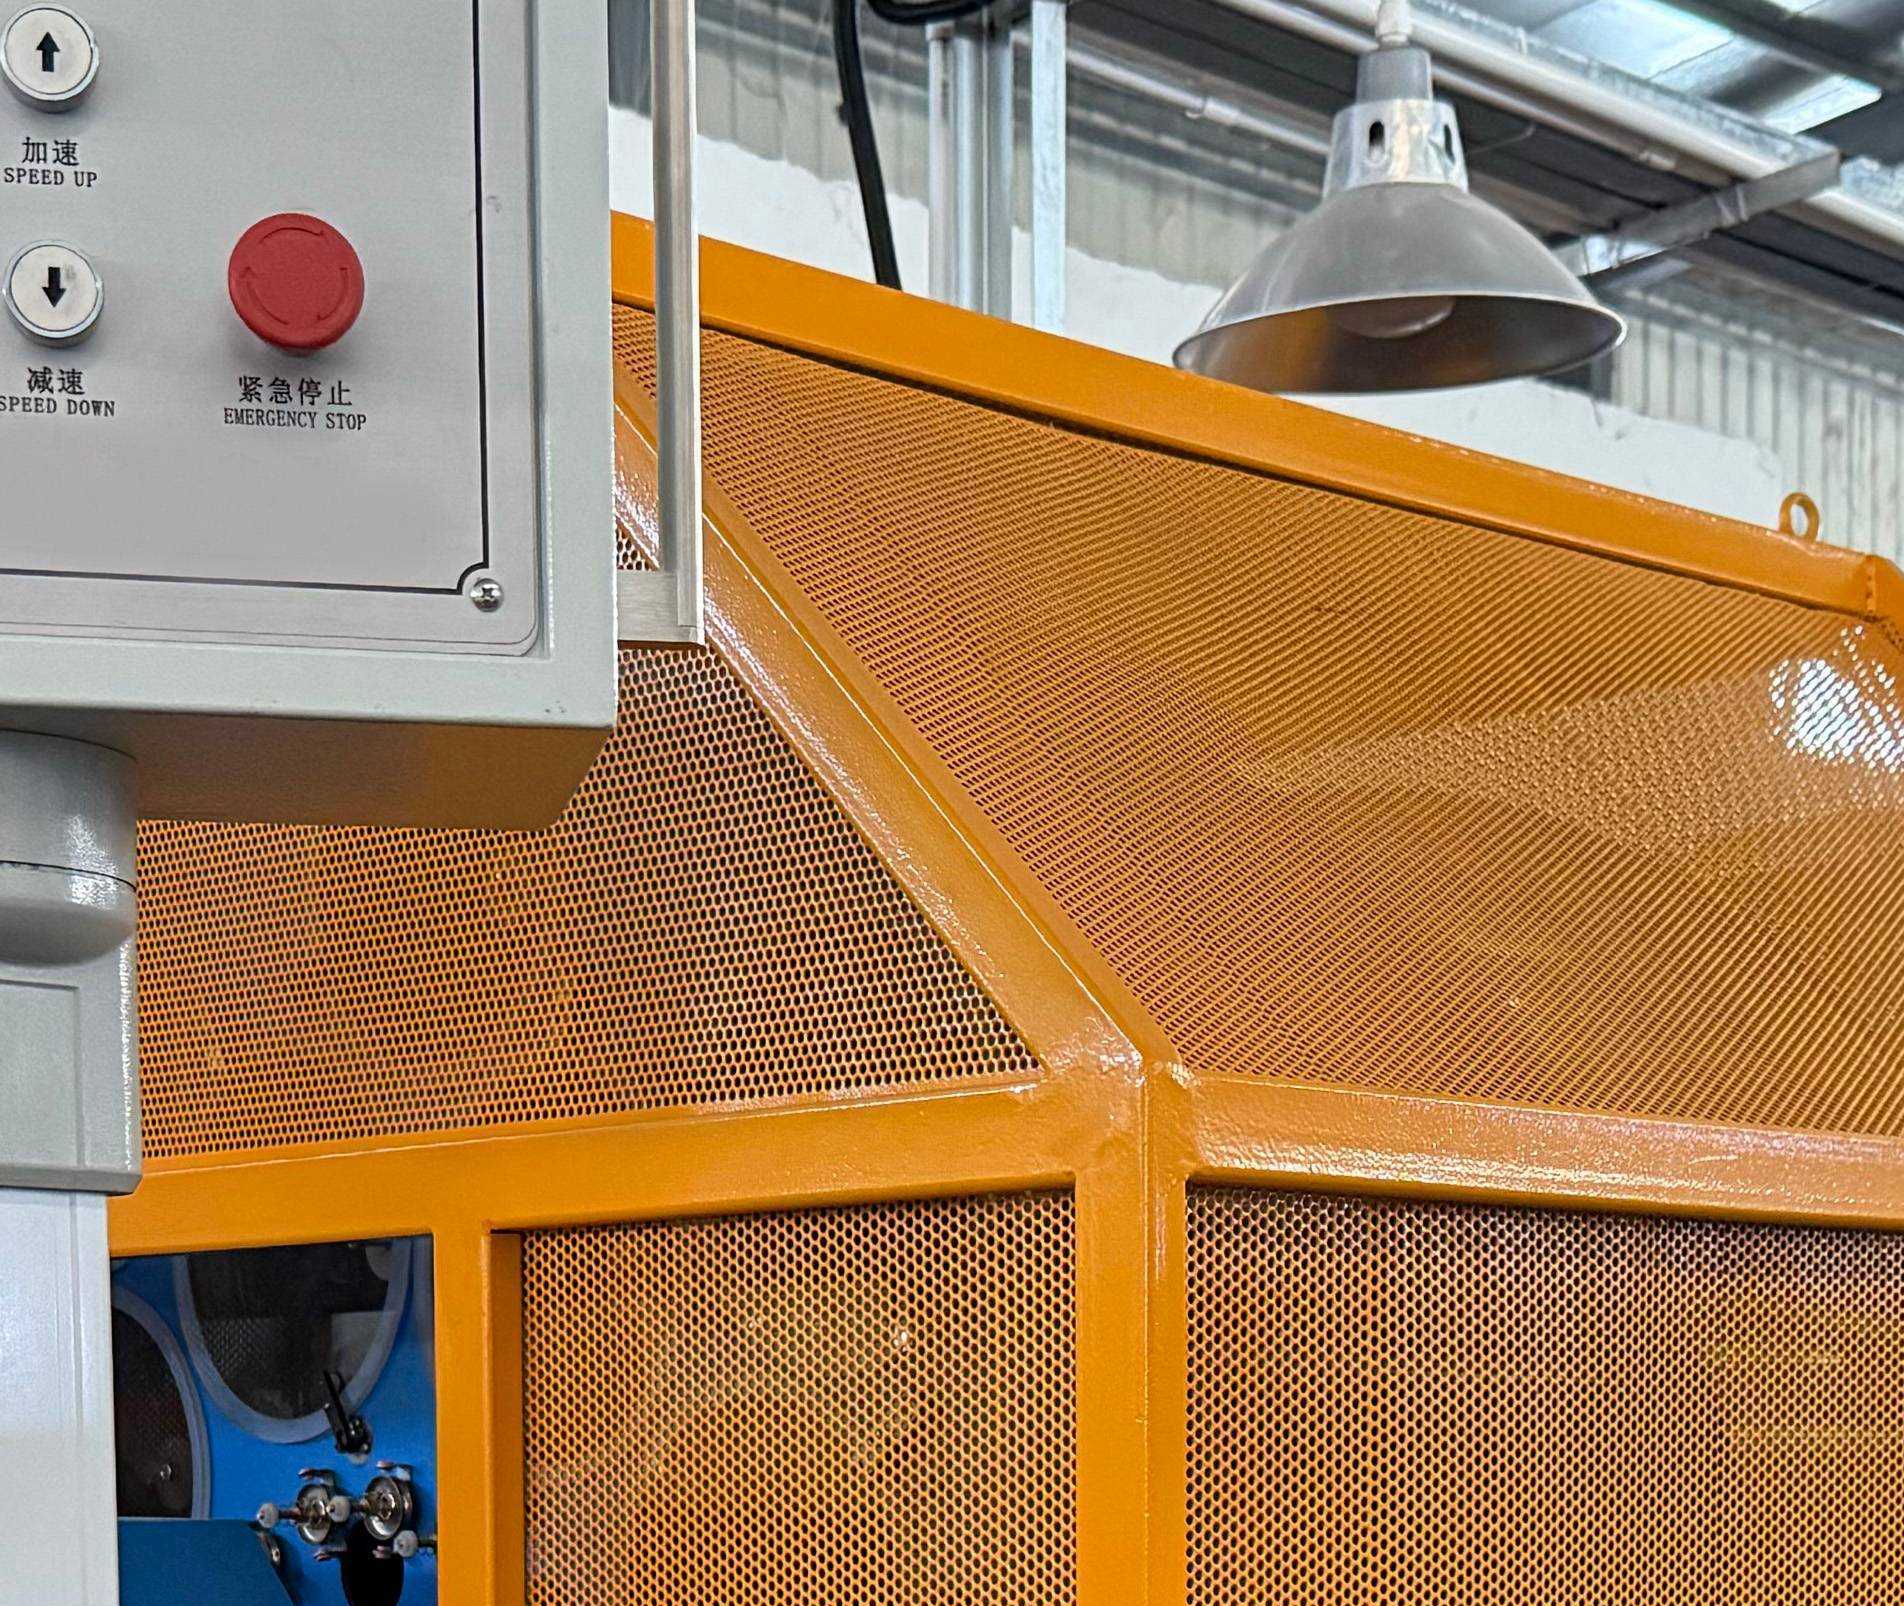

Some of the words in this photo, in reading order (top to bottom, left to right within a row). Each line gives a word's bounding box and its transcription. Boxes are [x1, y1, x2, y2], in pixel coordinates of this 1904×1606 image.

[22, 136, 80, 166] 加速
[3, 167, 65, 186] SPEED
[74, 171, 98, 188] UP
[26, 366, 85, 396] 减速
[238, 375, 353, 406] 紧急停止
[66, 398, 116, 417] DOWN
[223, 407, 318, 429] EMERGENCY
[326, 411, 367, 432] STOP
